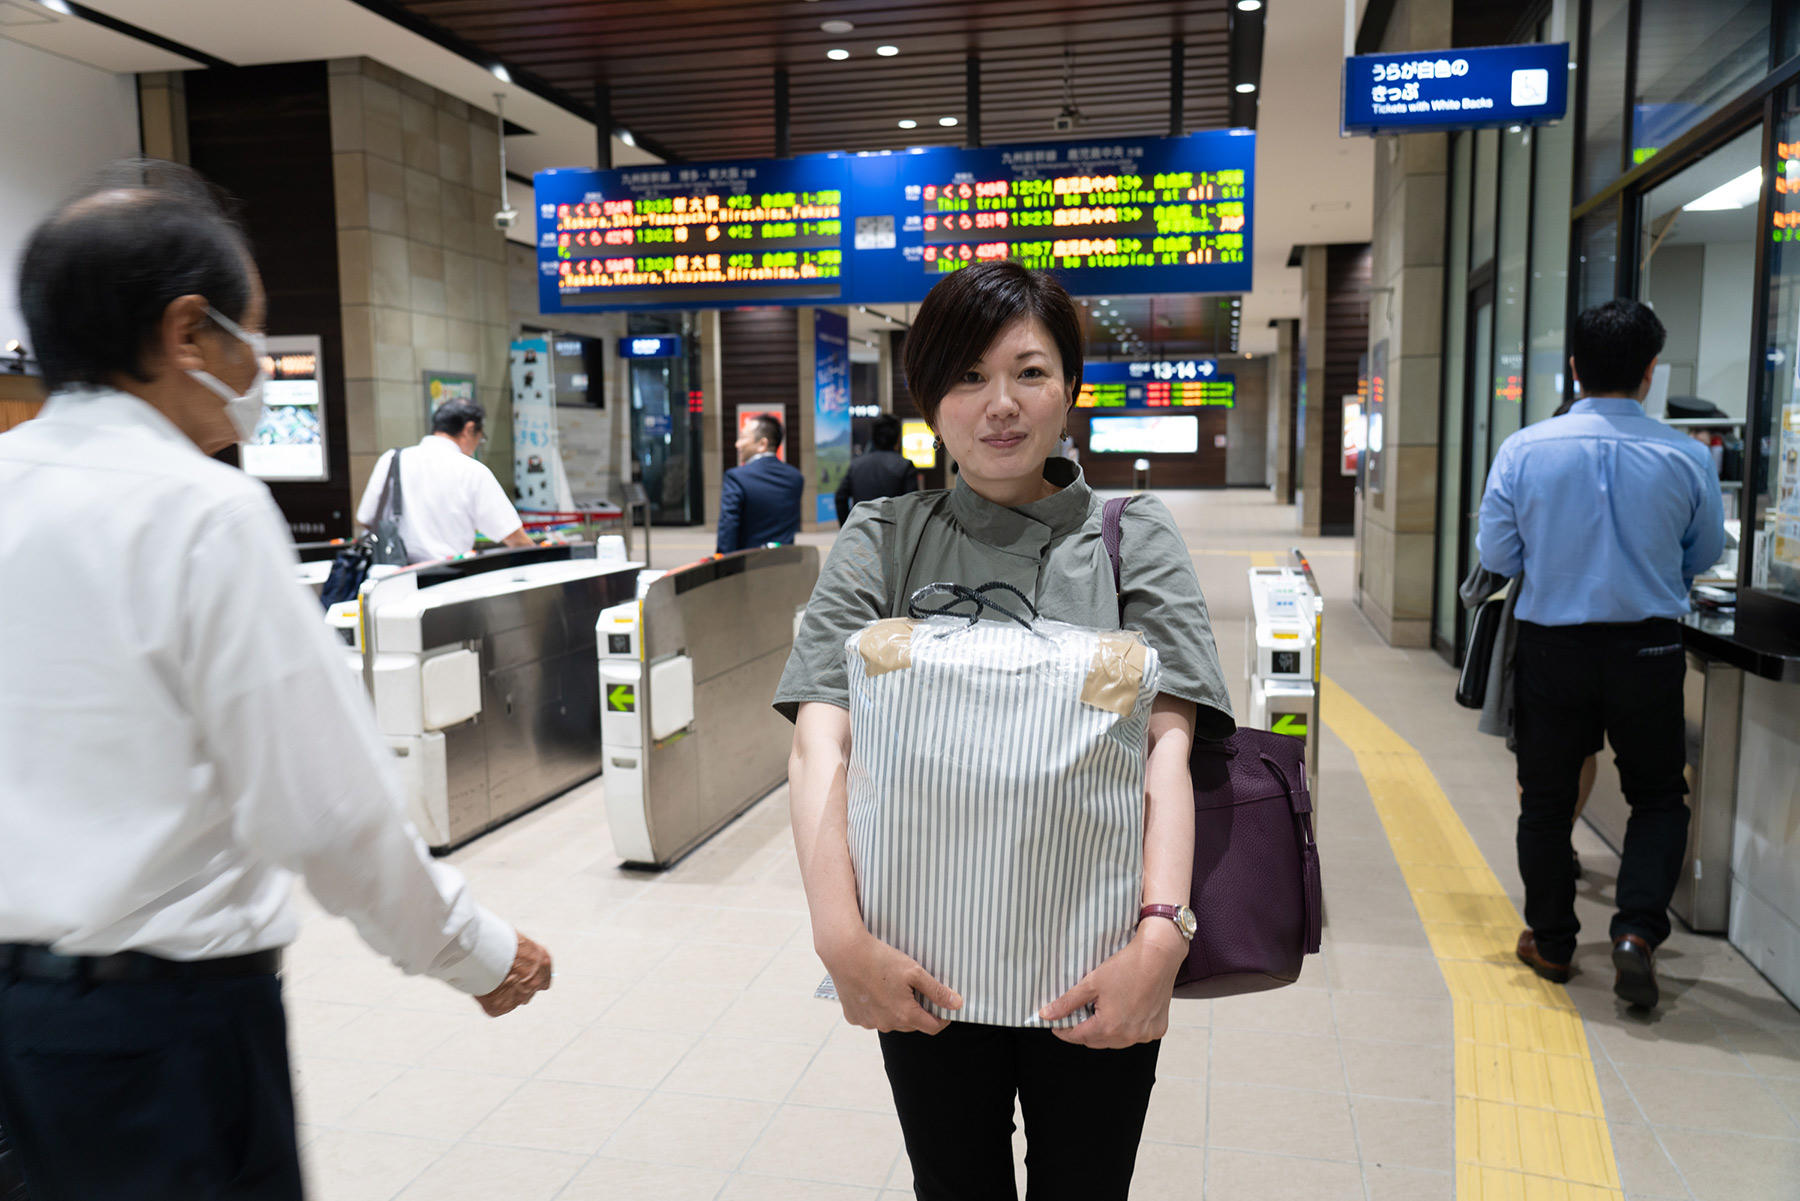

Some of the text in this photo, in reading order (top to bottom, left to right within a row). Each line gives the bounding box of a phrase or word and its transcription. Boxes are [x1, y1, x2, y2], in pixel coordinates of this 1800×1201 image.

[1371, 59, 1469, 82] うらが白色の
[1372, 82, 1420, 102] きっぷ
[1372, 97, 1494, 115] Tickets with White Backs
[1011, 179, 1053, 195] 12:34
[937, 196, 969, 211] This
[976, 195, 1017, 210] train
[1023, 192, 1055, 208] will
[1063, 193, 1081, 206] be
[1088, 189, 1155, 205] stopping
[1162, 188, 1179, 201] at
[1187, 184, 1213, 201] all
[1011, 210, 1053, 226] 13:23
[636, 227, 673, 243] 13:02
[1011, 241, 1052, 257] 13:57
[1063, 255, 1081, 268] be
[1088, 252, 1155, 267] stopping
[1162, 251, 1179, 265] at
[1186, 247, 1212, 265] all
